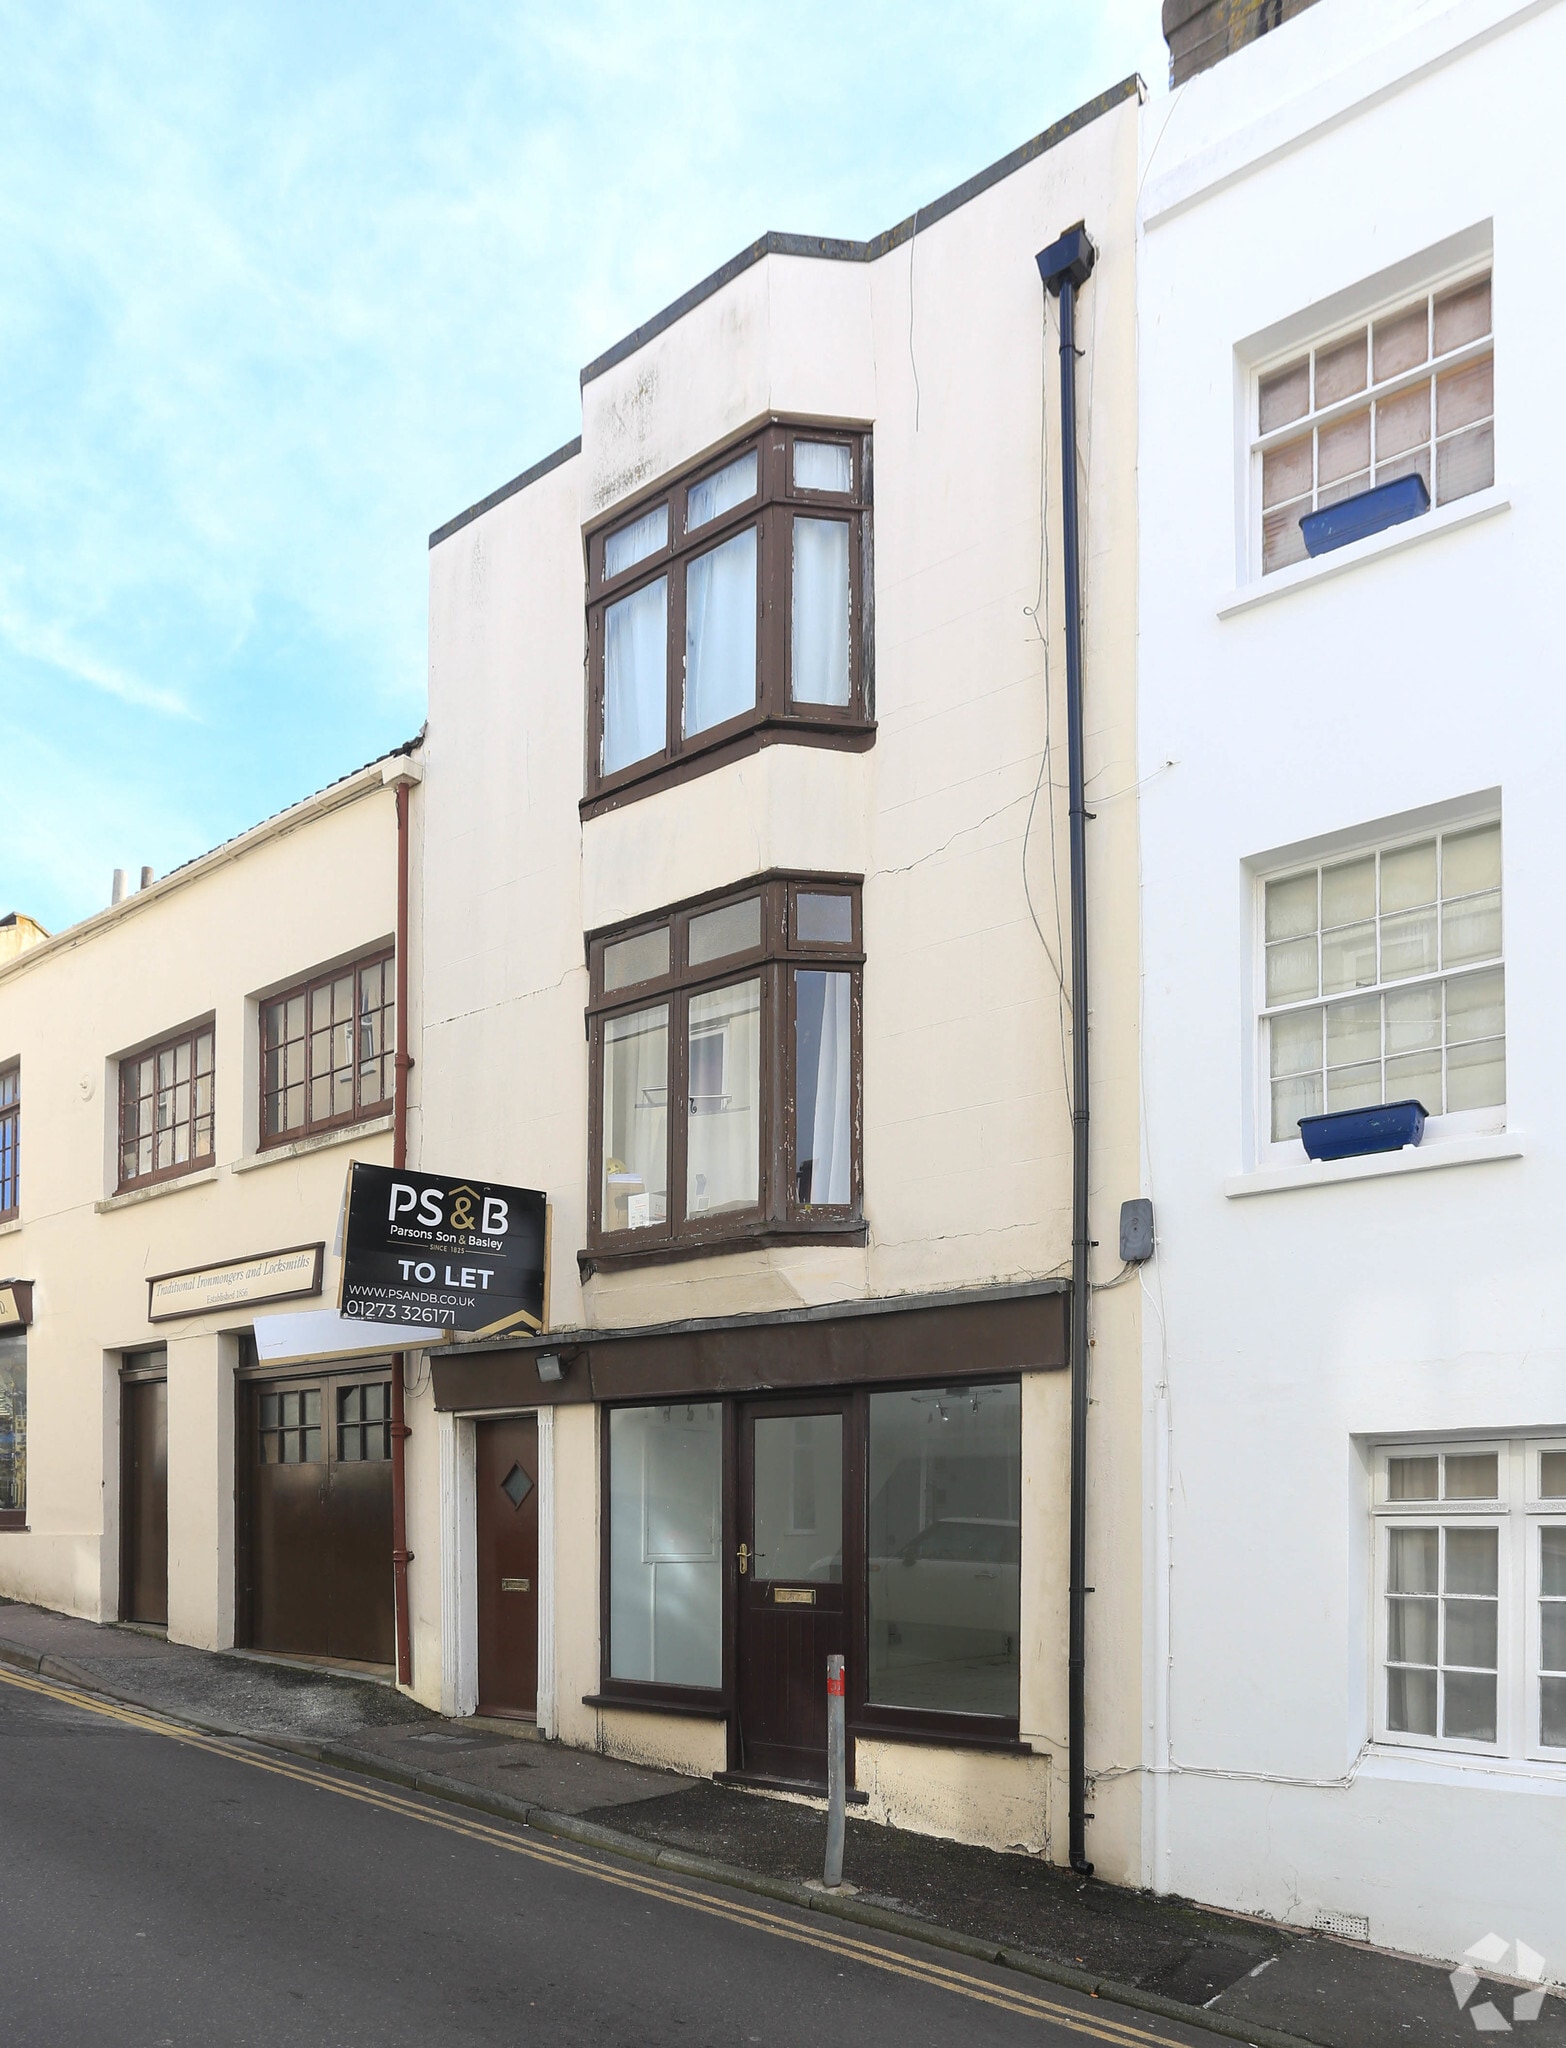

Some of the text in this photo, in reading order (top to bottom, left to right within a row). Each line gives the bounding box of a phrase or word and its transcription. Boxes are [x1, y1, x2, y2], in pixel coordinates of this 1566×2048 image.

[390, 1225, 503, 1251] Parsons Son & Basley
[429, 1243, 465, 1254] SINCE 1825
[156, 1254, 310, 1297] Traditional Ironmongers and Locksmiths
[398, 1260, 494, 1290] TO LET
[206, 1289, 236, 1304] Established
[348, 1284, 476, 1308] WWW.PSANDB.CO.UK
[346, 1299, 455, 1324] 01273 326171
